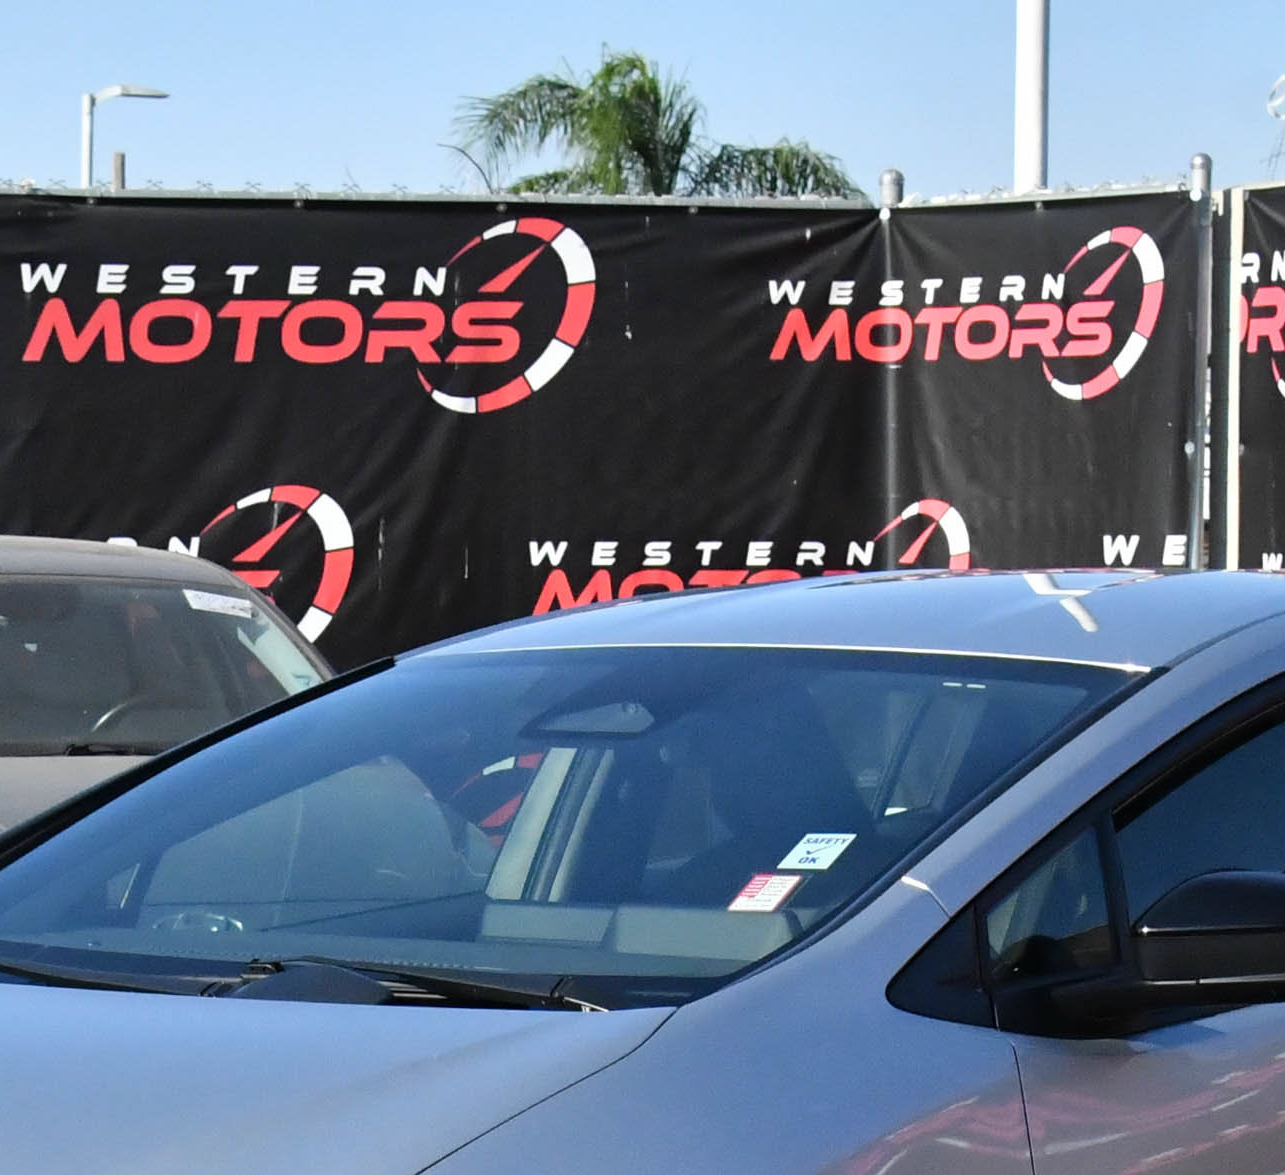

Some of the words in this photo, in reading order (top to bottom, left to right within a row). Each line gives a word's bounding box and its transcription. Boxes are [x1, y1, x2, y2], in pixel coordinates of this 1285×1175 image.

[20, 263, 448, 297] WESTERN
[768, 273, 1066, 306] WESTERN
[21, 298, 524, 364] MOTORS
[769, 301, 1115, 363] MOTORS
[528, 540, 876, 566] WESTERN
[803, 837, 849, 845] SAFETY
[798, 857, 818, 865] OK
